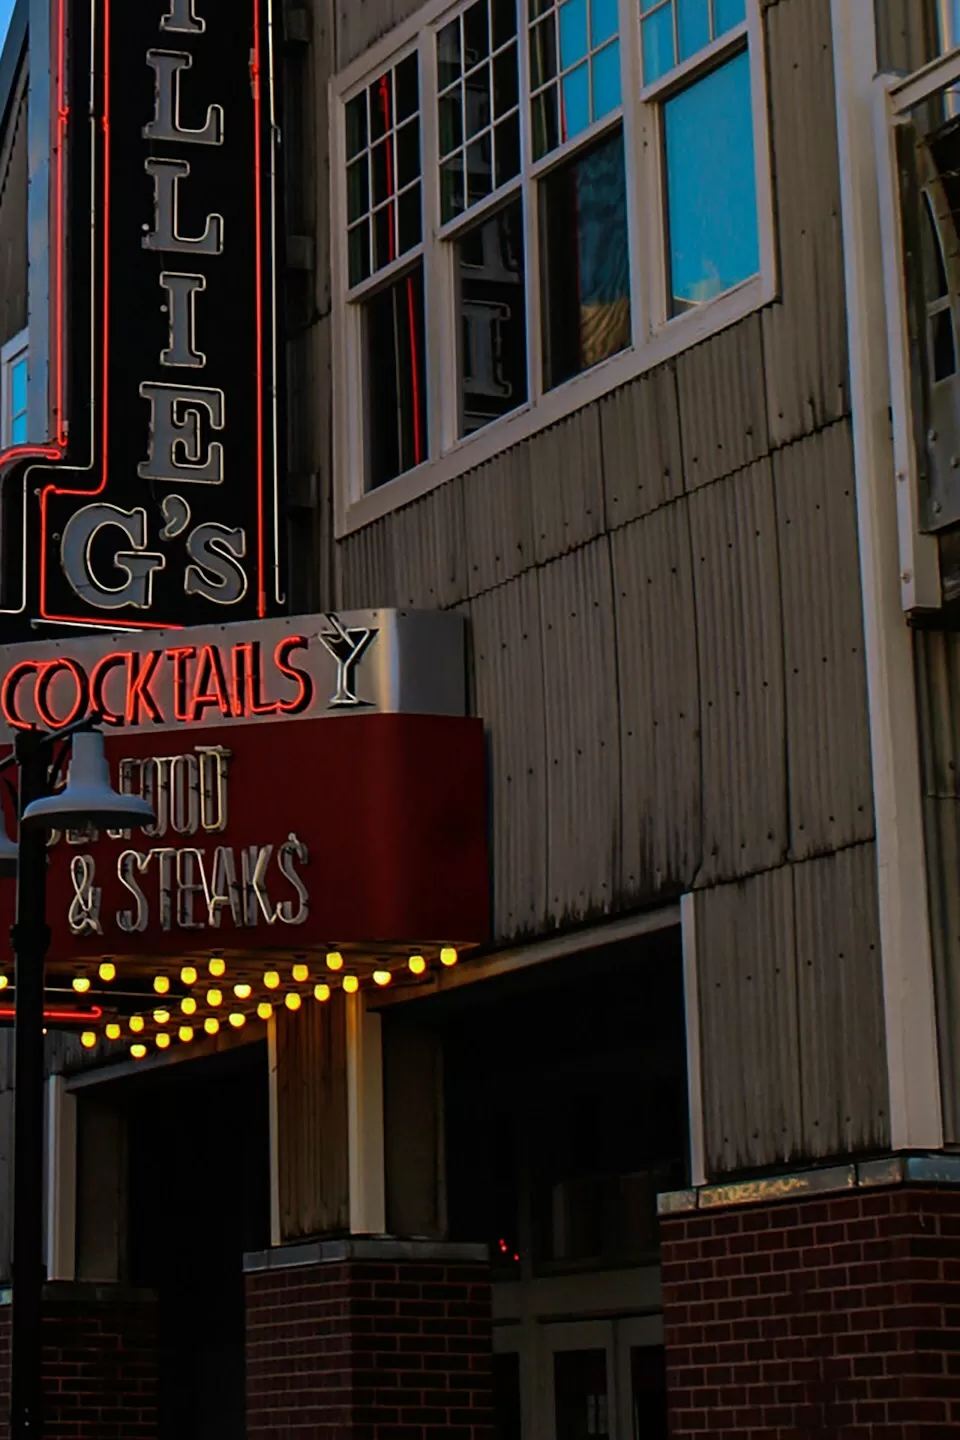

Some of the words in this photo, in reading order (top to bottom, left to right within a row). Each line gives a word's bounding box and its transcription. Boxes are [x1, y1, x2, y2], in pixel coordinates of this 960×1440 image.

[1, 635, 313, 730] COCKTAILS
[46, 745, 231, 846] FOOD
[69, 855, 102, 935] &
[116, 832, 309, 932] STEAKS
